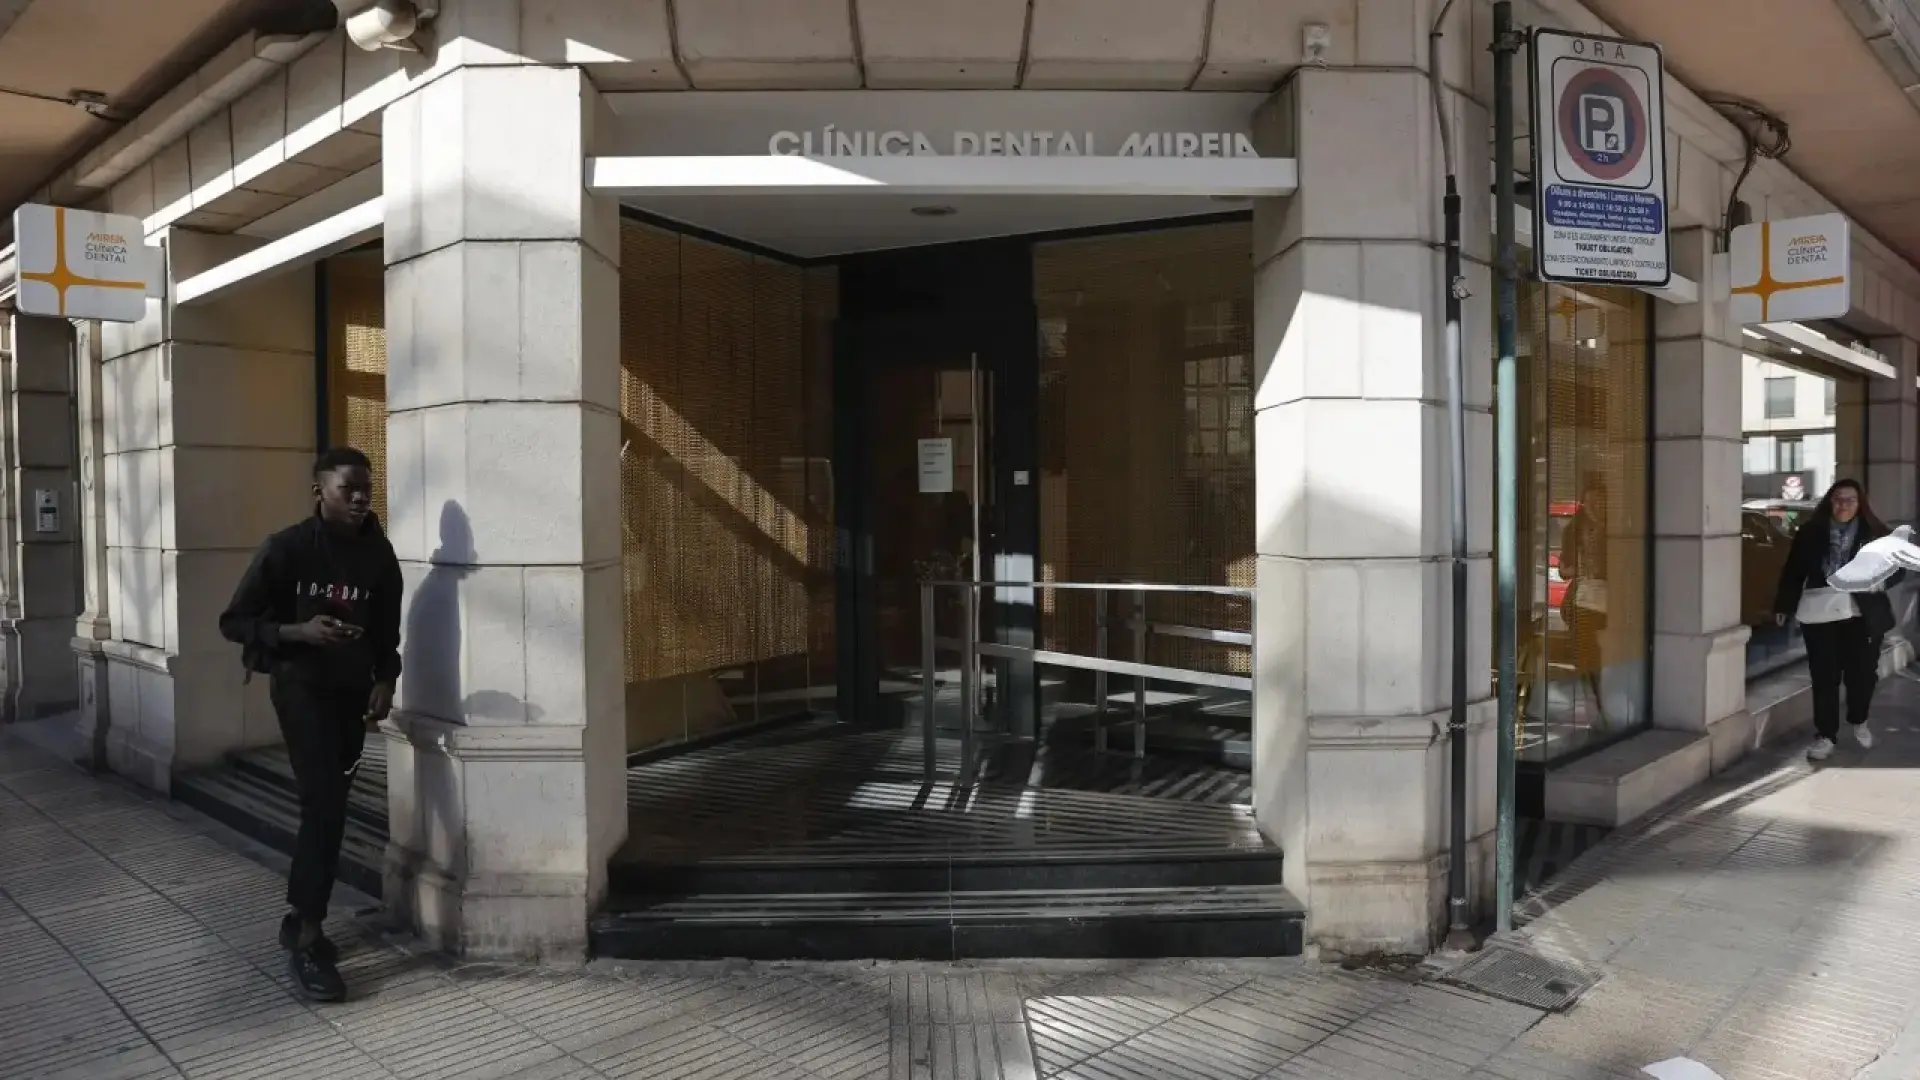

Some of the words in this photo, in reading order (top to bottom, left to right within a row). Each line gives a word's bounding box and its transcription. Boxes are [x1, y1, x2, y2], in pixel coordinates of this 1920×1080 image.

[1573, 39, 1625, 59] ORA
[85, 251, 126, 264] DENTAL
[1787, 254, 1828, 265] DENTAL
